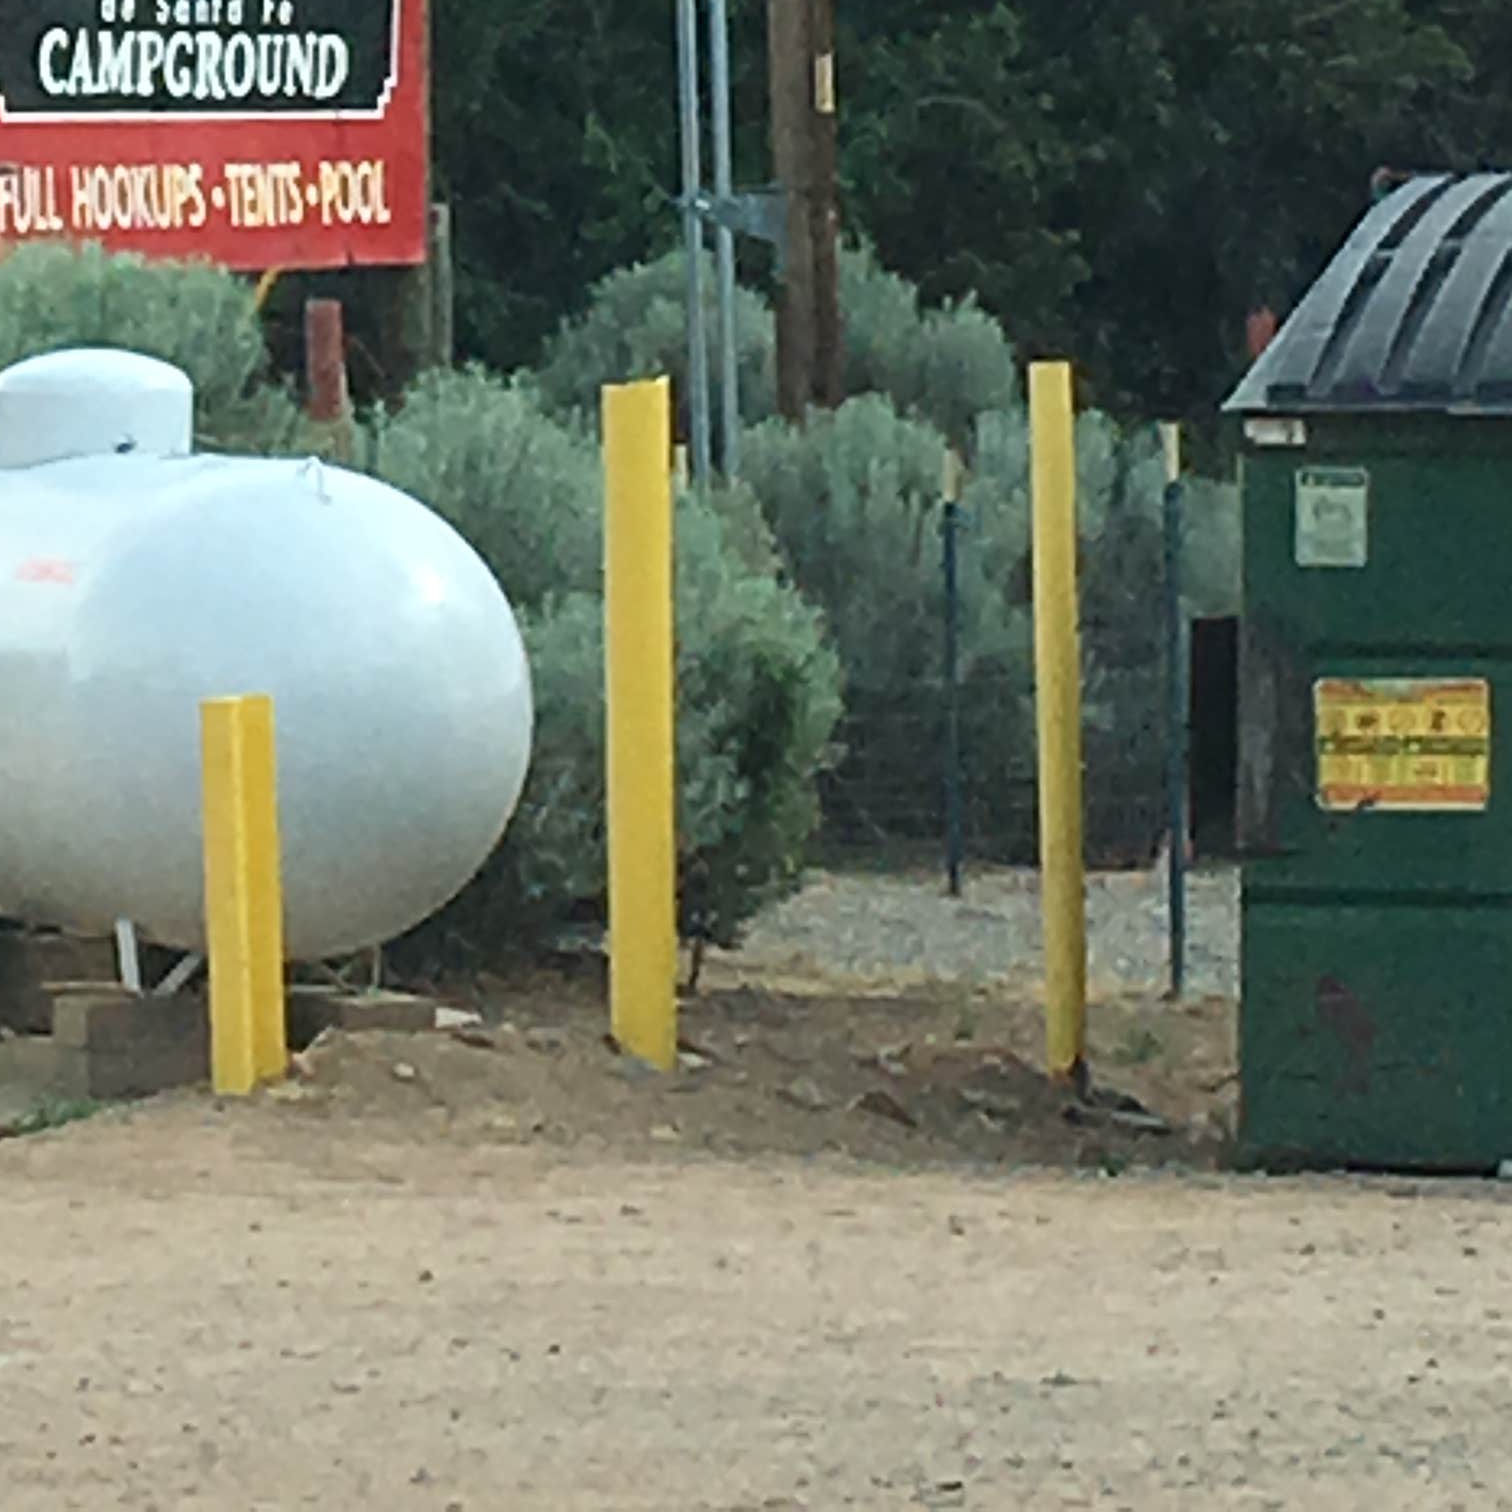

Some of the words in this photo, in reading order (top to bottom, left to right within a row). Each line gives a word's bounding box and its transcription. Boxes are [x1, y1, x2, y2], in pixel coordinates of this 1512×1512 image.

[38, 28, 350, 100] CAMPGROUND
[70, 162, 206, 229] HOOKUPS
[319, 159, 391, 225] POOL
